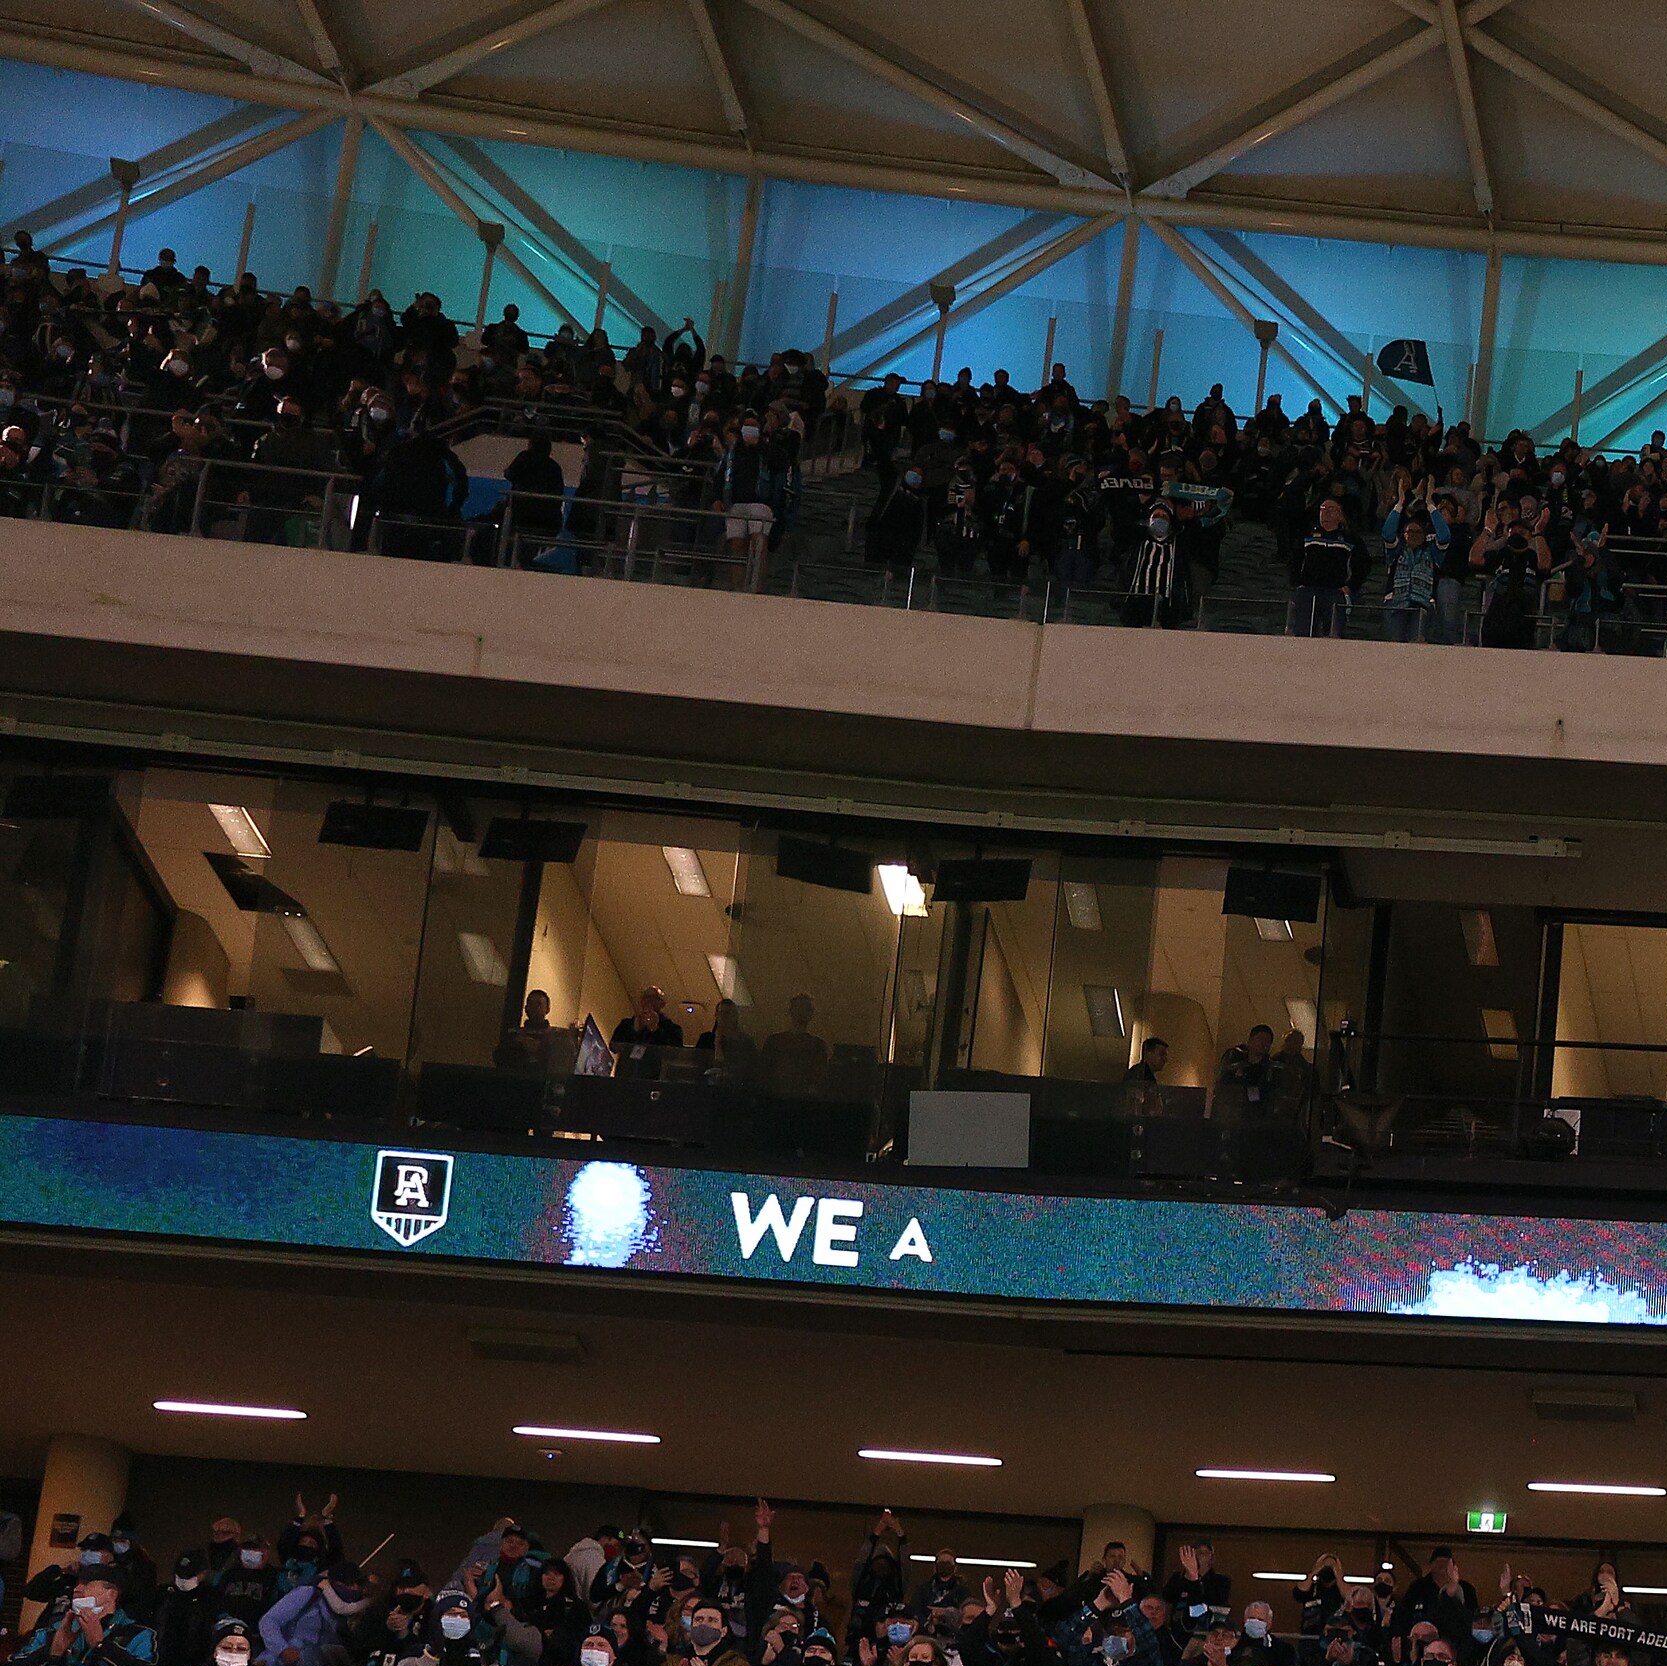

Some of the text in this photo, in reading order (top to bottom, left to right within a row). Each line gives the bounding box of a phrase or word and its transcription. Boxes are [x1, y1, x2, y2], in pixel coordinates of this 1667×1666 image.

[730, 1192, 933, 1266] WE A
[1545, 1612, 1567, 1628] WE
[1570, 1616, 1597, 1634] ARE
[1600, 1621, 1634, 1640] PORT
